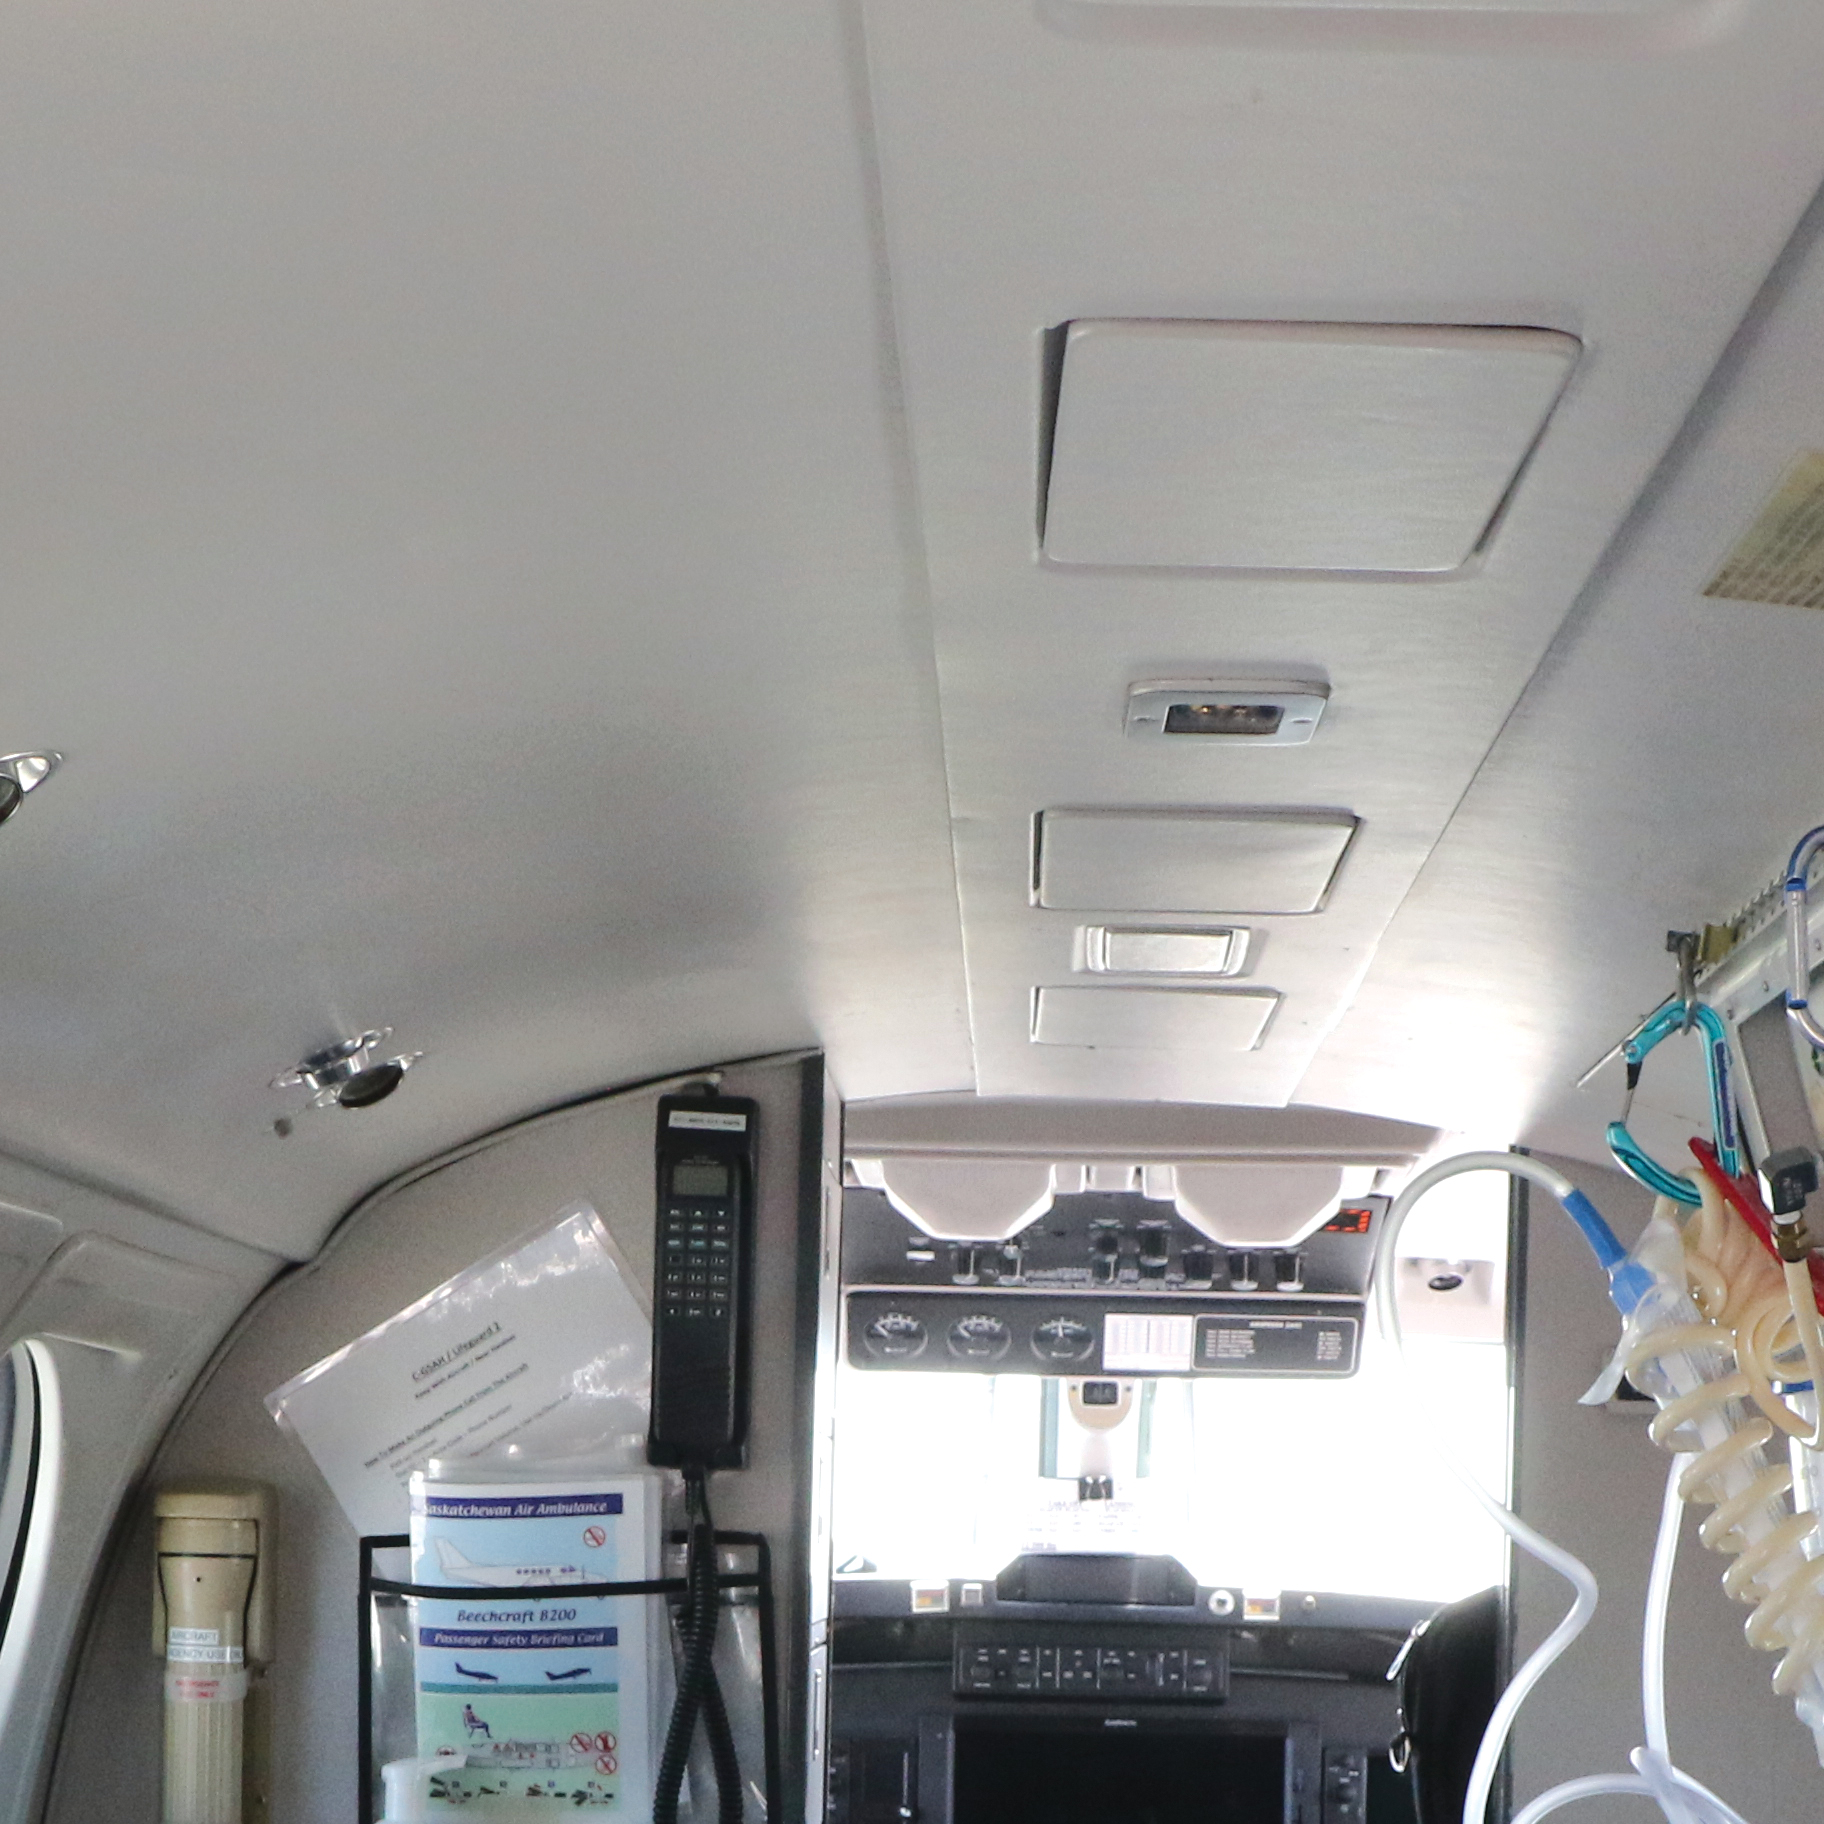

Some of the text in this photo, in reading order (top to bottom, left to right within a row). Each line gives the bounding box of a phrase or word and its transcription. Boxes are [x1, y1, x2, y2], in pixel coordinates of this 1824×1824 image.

[513, 1503, 534, 1516] Air
[536, 1501, 608, 1516] Ambulance
[457, 1608, 577, 1624] Beechcraft B200
[433, 1631, 605, 1646] Passenger Safety Briefing Card
